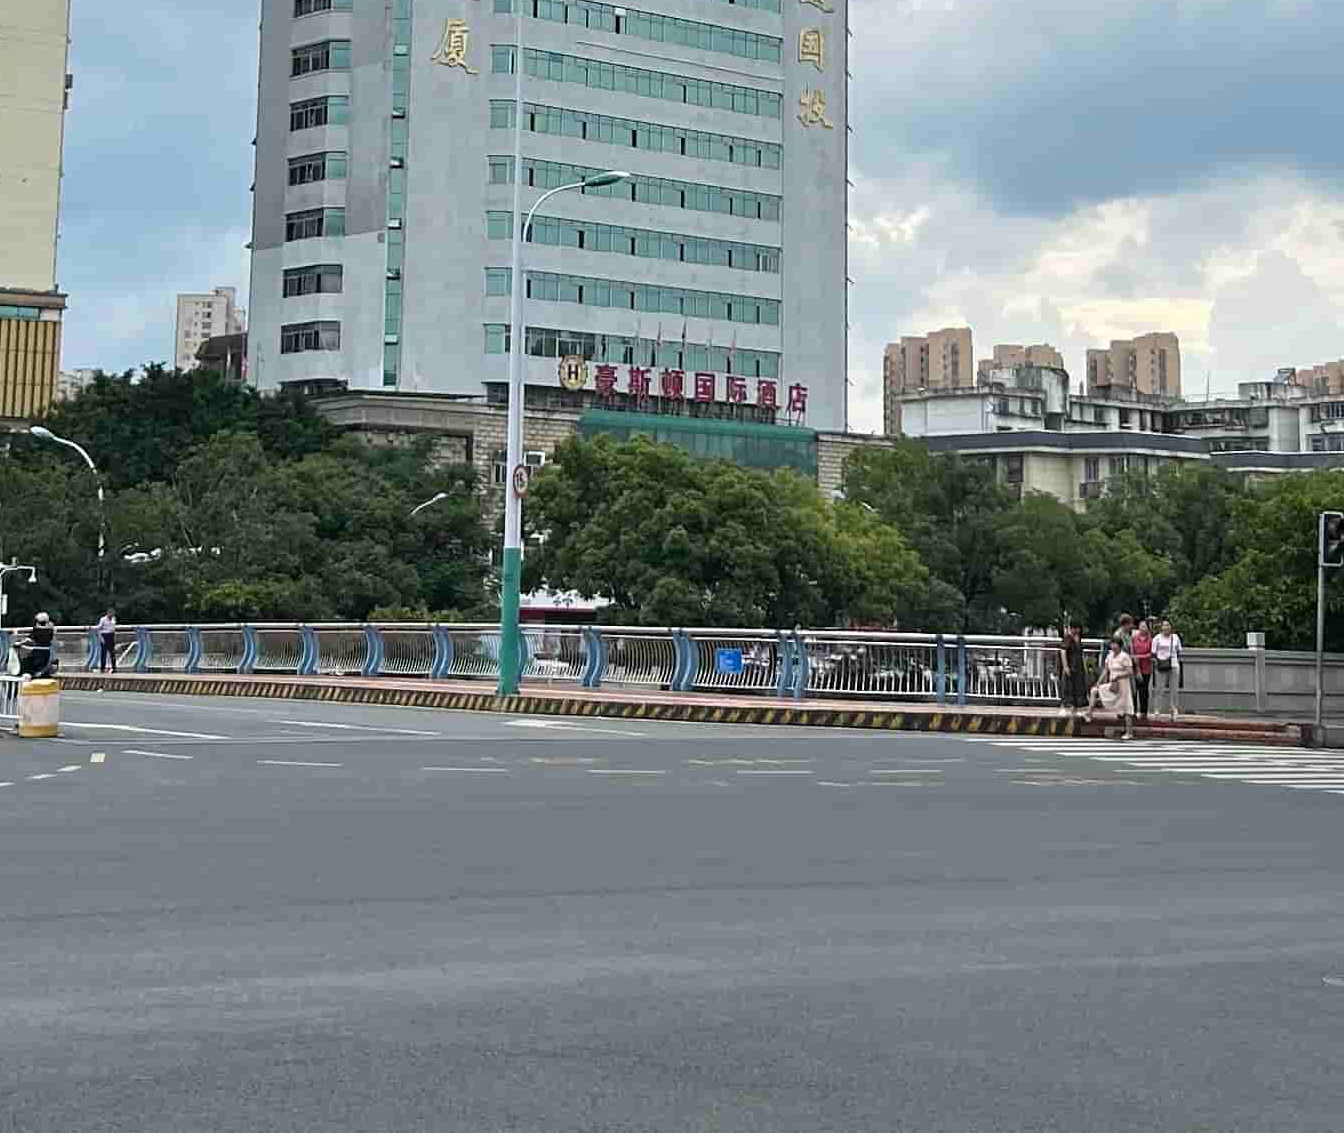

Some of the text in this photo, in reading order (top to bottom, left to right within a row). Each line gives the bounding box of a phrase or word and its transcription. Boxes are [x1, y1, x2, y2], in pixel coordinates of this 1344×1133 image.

[595, 365, 808, 413] 豪斯顿国际酒店
